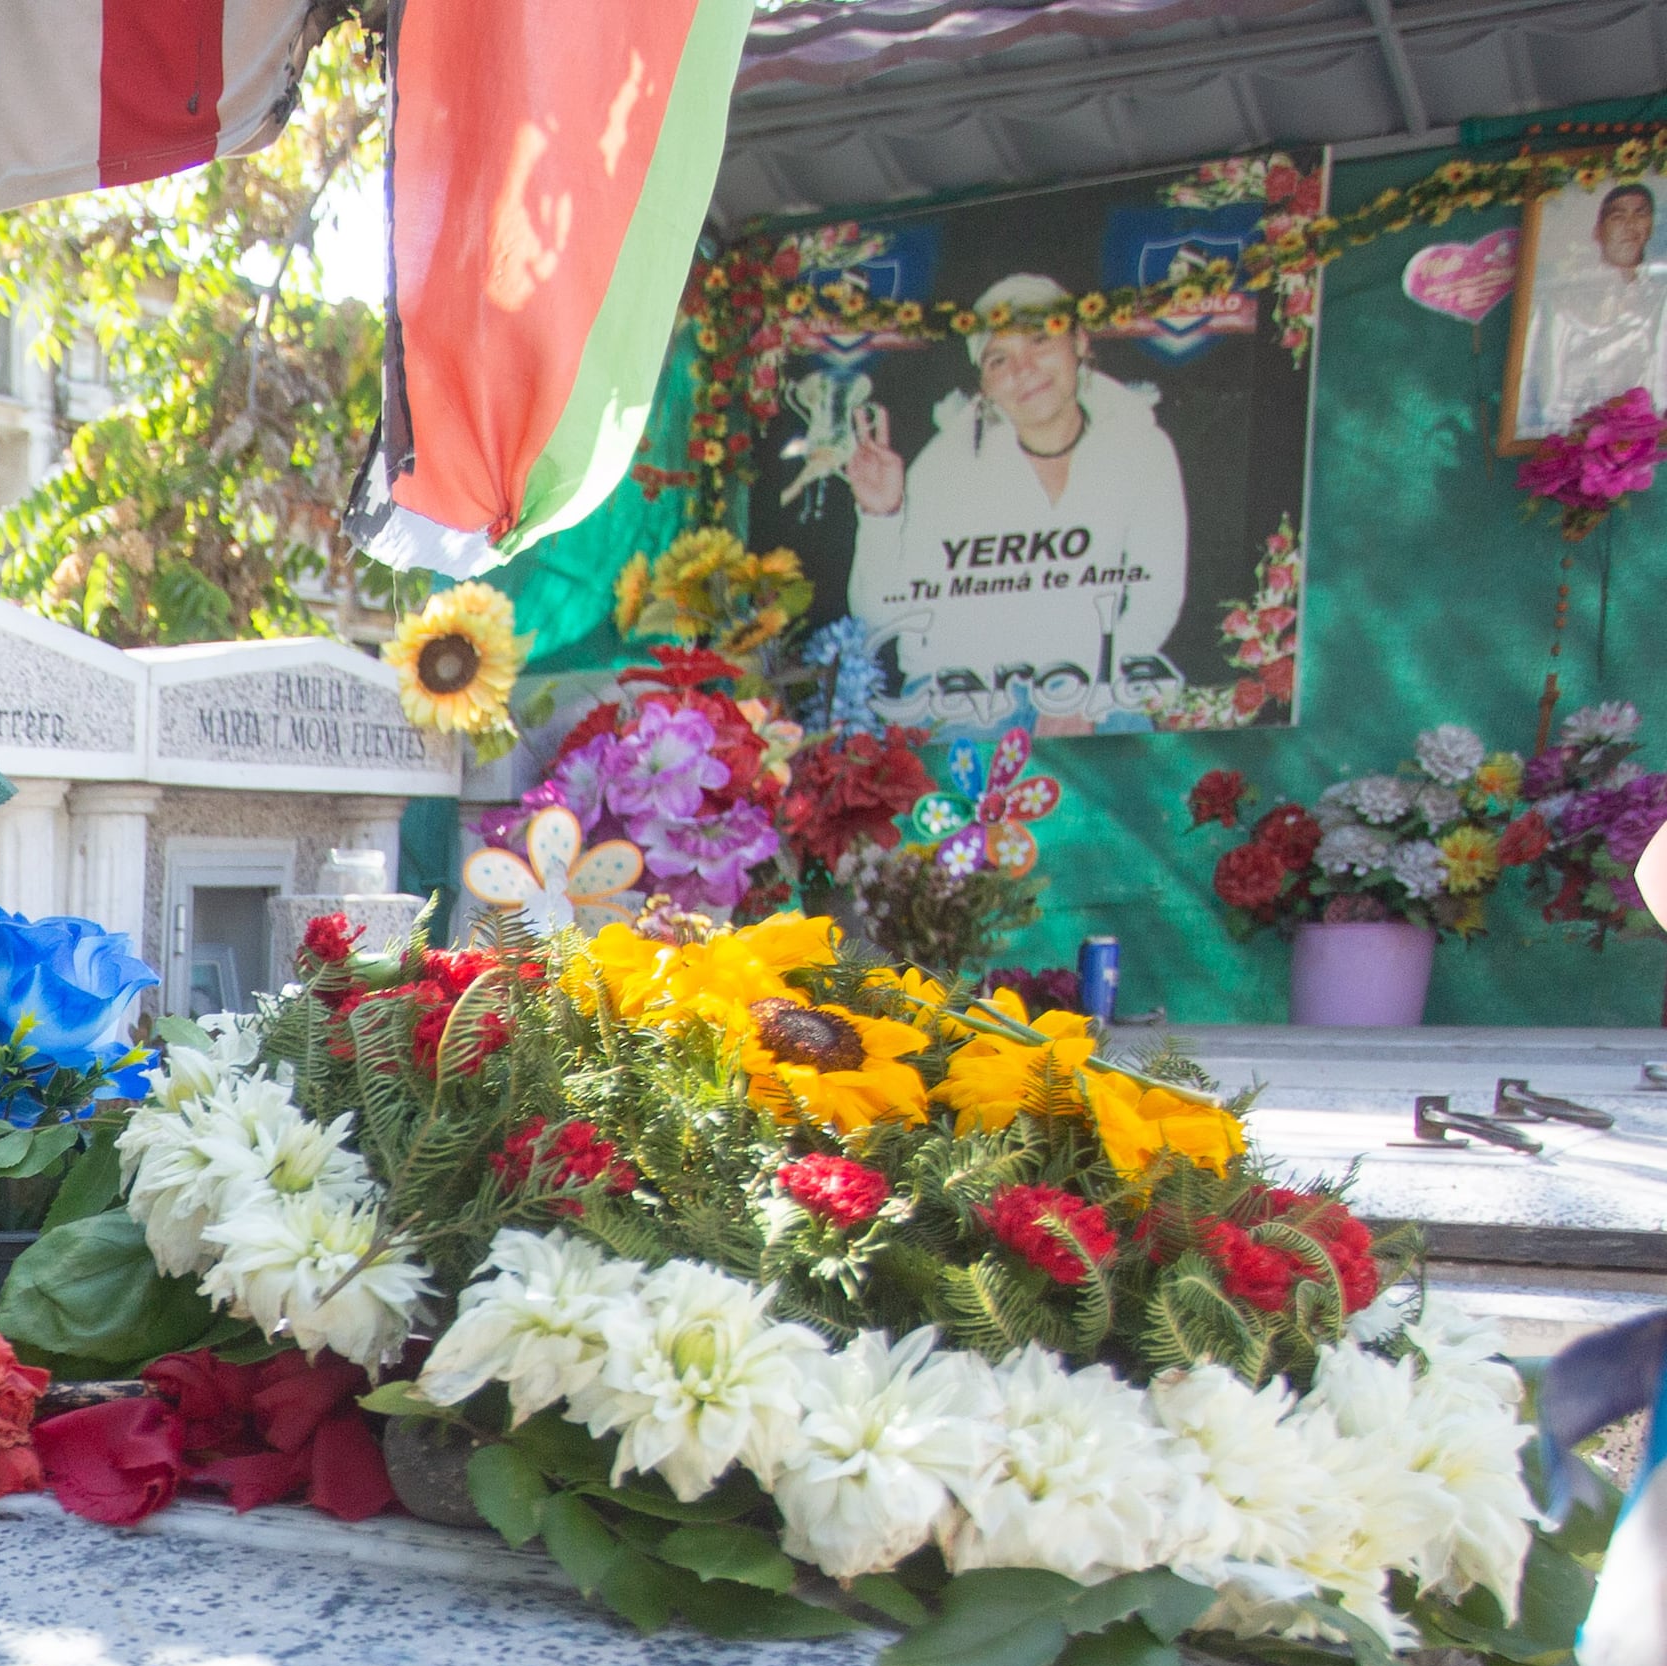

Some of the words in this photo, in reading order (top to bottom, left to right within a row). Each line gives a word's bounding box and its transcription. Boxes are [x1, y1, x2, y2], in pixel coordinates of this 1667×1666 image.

[942, 527, 1091, 571] YERKO
[950, 569, 1031, 598] Mamá
[1041, 570, 1070, 592] te
[1081, 562, 1151, 588] Ama.
[868, 594, 1184, 728] Carola
[274, 672, 344, 713] FAMILIA
[351, 721, 427, 760] FUENTES
